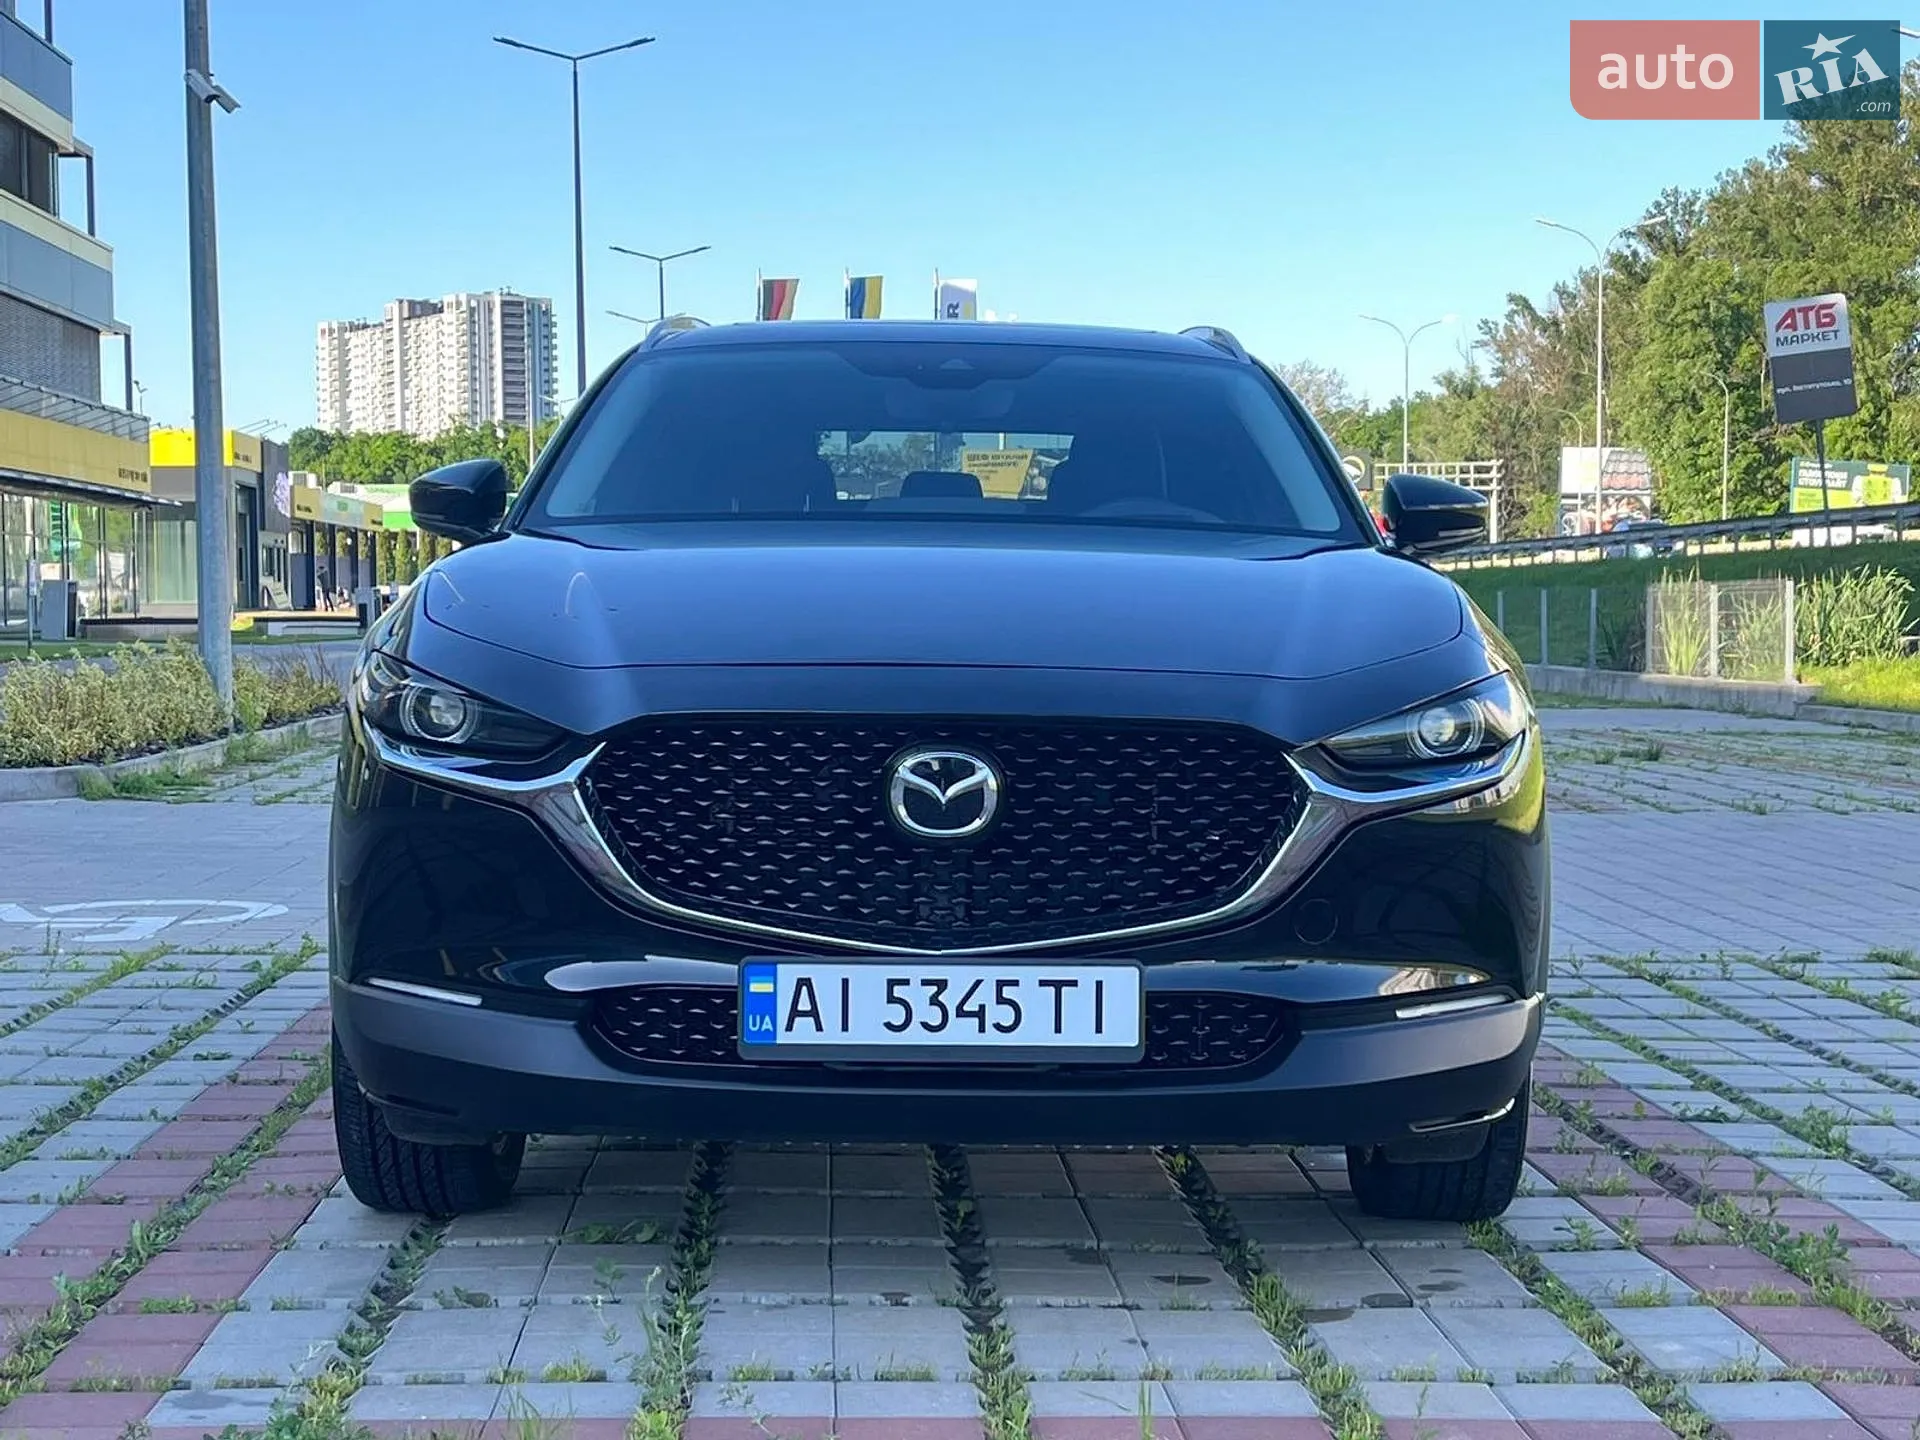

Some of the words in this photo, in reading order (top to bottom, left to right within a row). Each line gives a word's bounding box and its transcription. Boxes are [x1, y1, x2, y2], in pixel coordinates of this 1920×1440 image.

[1775, 302, 1838, 332] АТБ
[1775, 330, 1840, 347] МАРКЕТ
[784, 977, 849, 1033] AI
[882, 978, 1022, 1034] 5345
[1038, 979, 1104, 1035] TI
[748, 1014, 774, 1032] UA
